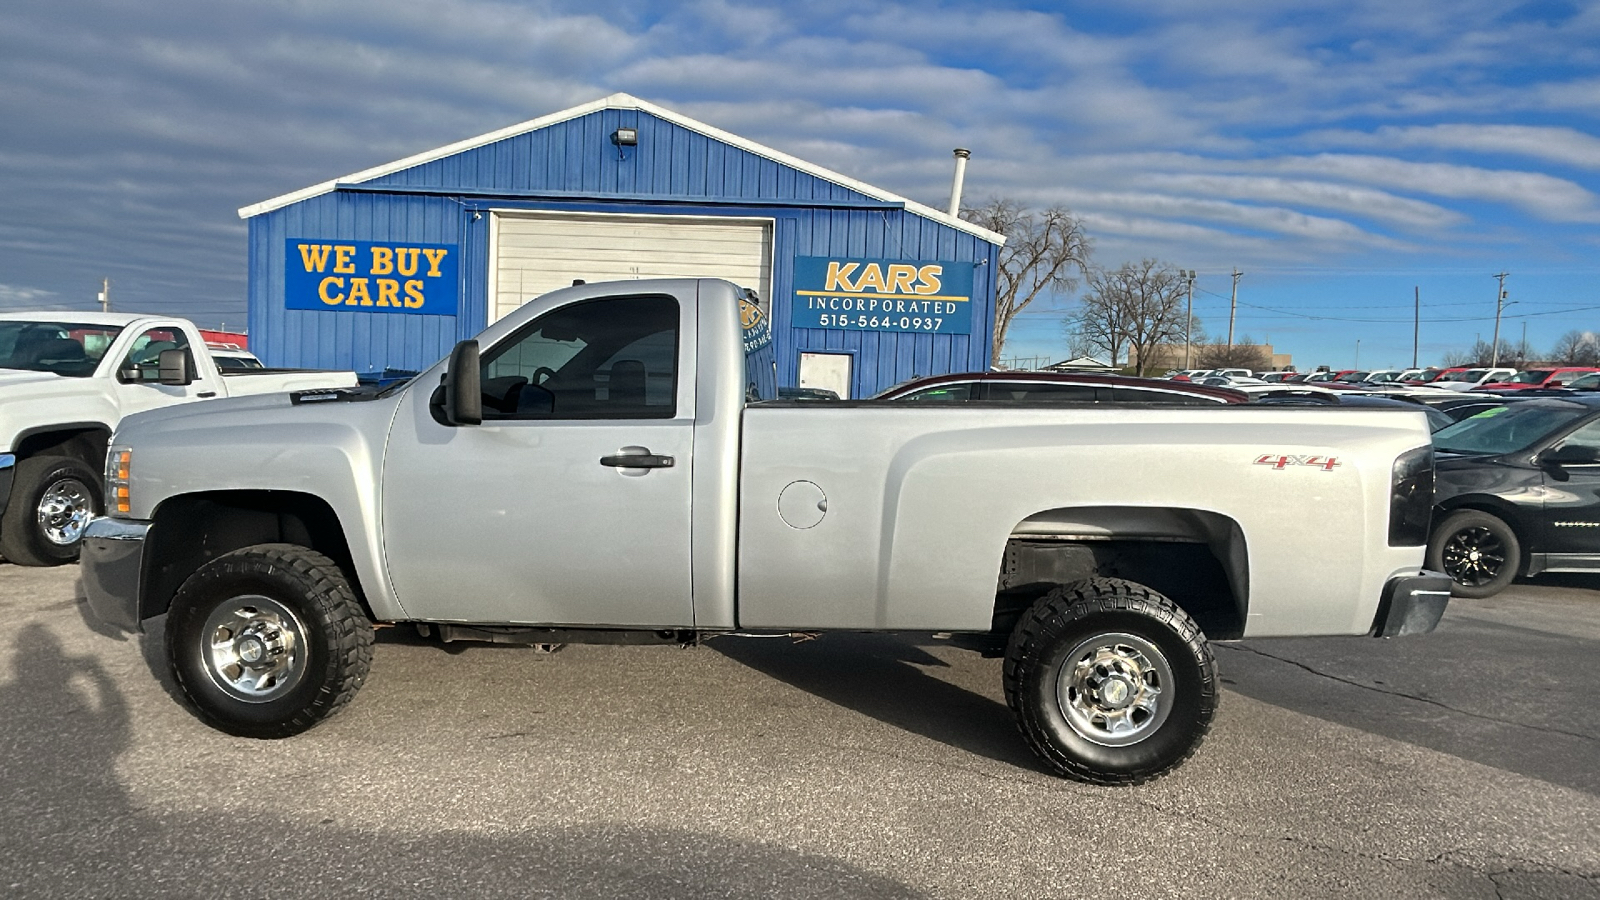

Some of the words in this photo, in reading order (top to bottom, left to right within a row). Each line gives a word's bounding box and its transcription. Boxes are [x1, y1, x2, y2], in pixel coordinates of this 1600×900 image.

[298, 244, 356, 273] WE
[370, 246, 447, 277] BUY
[318, 276, 425, 308] CARS
[824, 261, 943, 294] KARS
[808, 297, 956, 313] INCORPORATED
[820, 314, 943, 330] 515-564-0937
